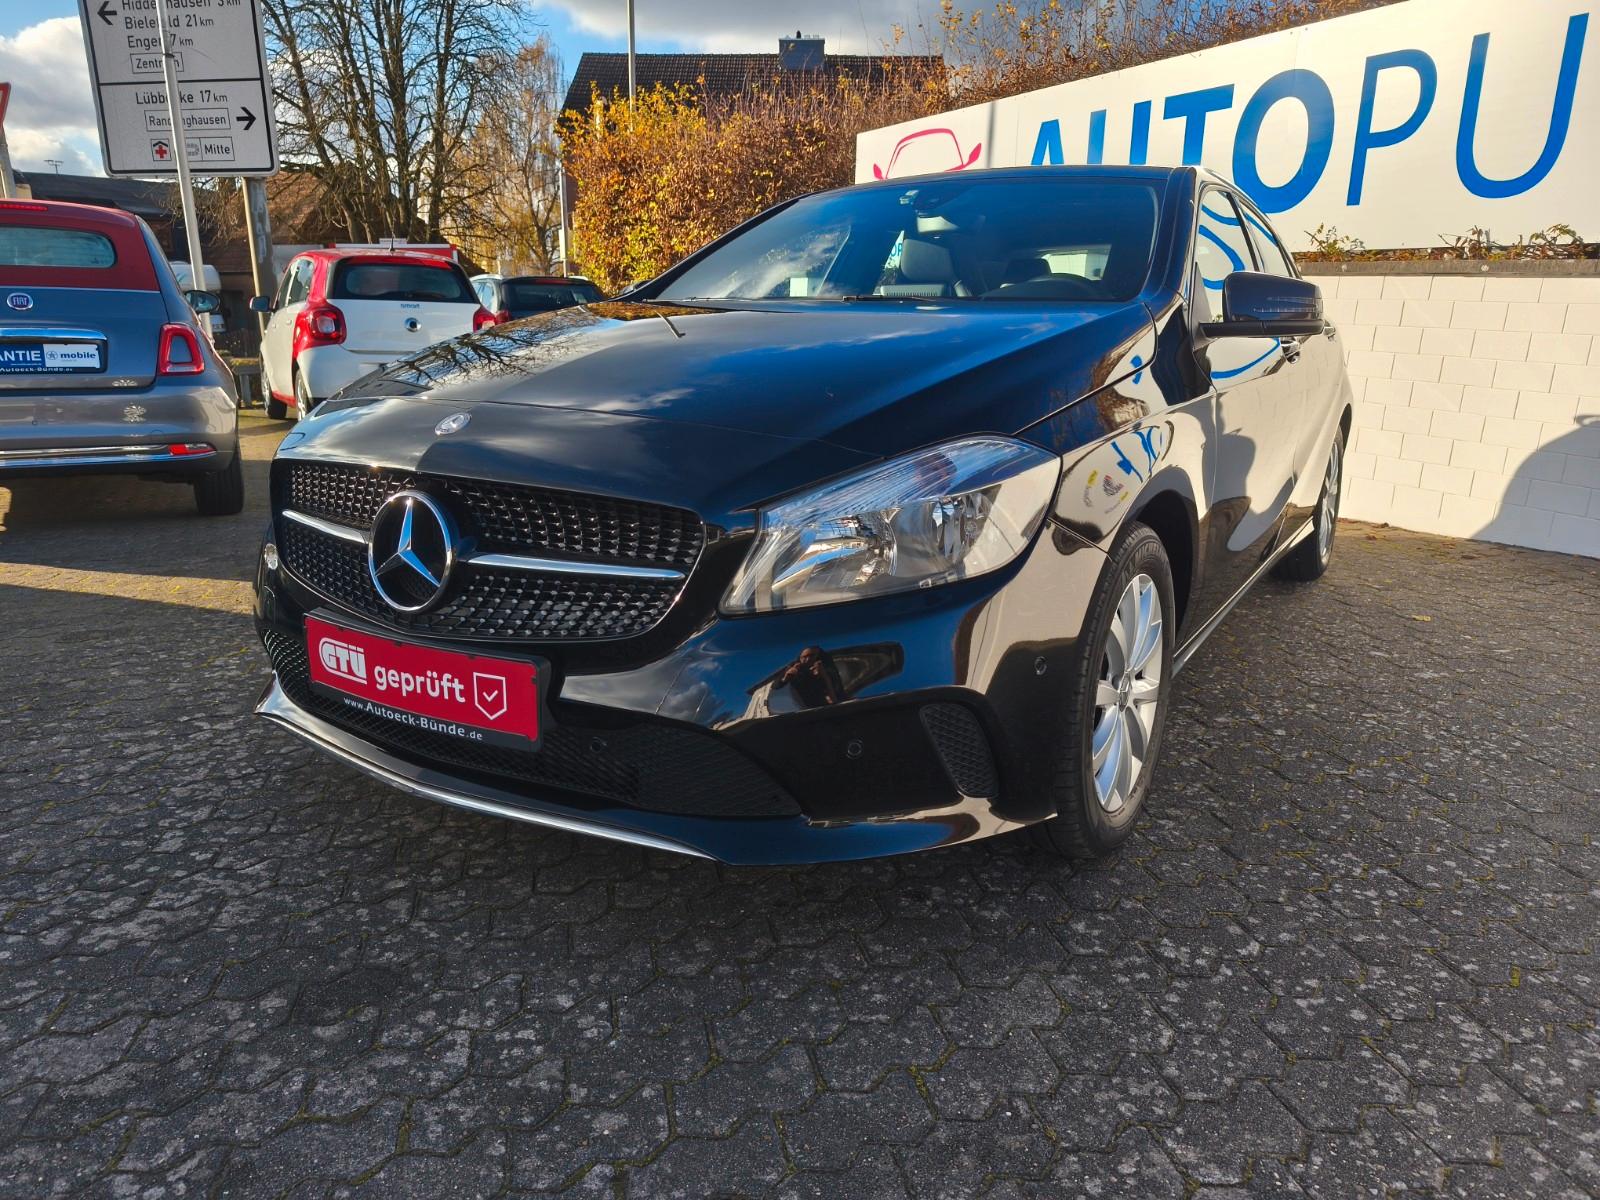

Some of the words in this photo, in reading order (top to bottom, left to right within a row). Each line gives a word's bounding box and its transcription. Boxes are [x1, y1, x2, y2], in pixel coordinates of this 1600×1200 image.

[122, 0, 211, 11] Hiddehausen
[124, 14, 180, 30] Bieleld
[185, 14, 198, 28] 21
[200, 16, 214, 27] km
[168, 33, 177, 47] 7
[179, 37, 194, 47] km
[135, 57, 181, 70] Zentrm
[135, 90, 194, 105] Lübbke
[199, 89, 211, 103] 17
[213, 92, 228, 103] km
[204, 144, 231, 155] Mitte
[0, 350, 42, 361] NTIE
[60, 351, 97, 359] mobile
[320, 640, 368, 682] GTÜ
[374, 664, 467, 704] geprüft
[342, 696, 484, 741] www.Autoeck-Bünde.de
